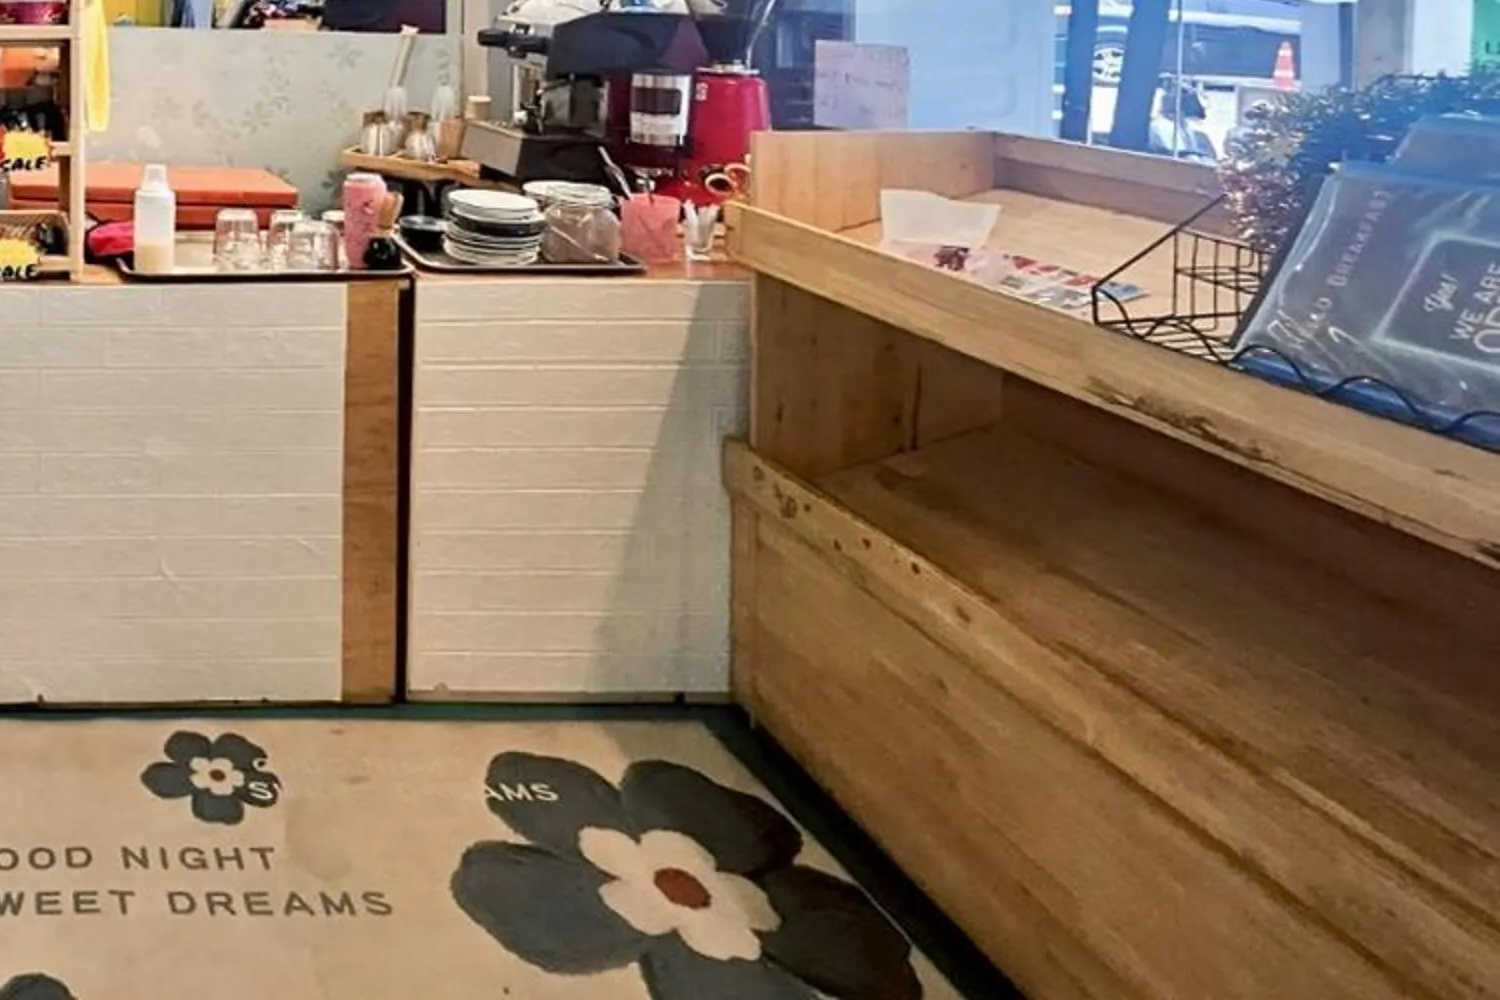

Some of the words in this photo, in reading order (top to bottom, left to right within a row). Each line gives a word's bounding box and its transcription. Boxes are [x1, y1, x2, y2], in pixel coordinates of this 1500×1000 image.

[0, 156, 47, 172] SALE
[1449, 307, 1484, 340] WE
[120, 846, 276, 871] NIGHT
[167, 890, 394, 917] DREAMS
